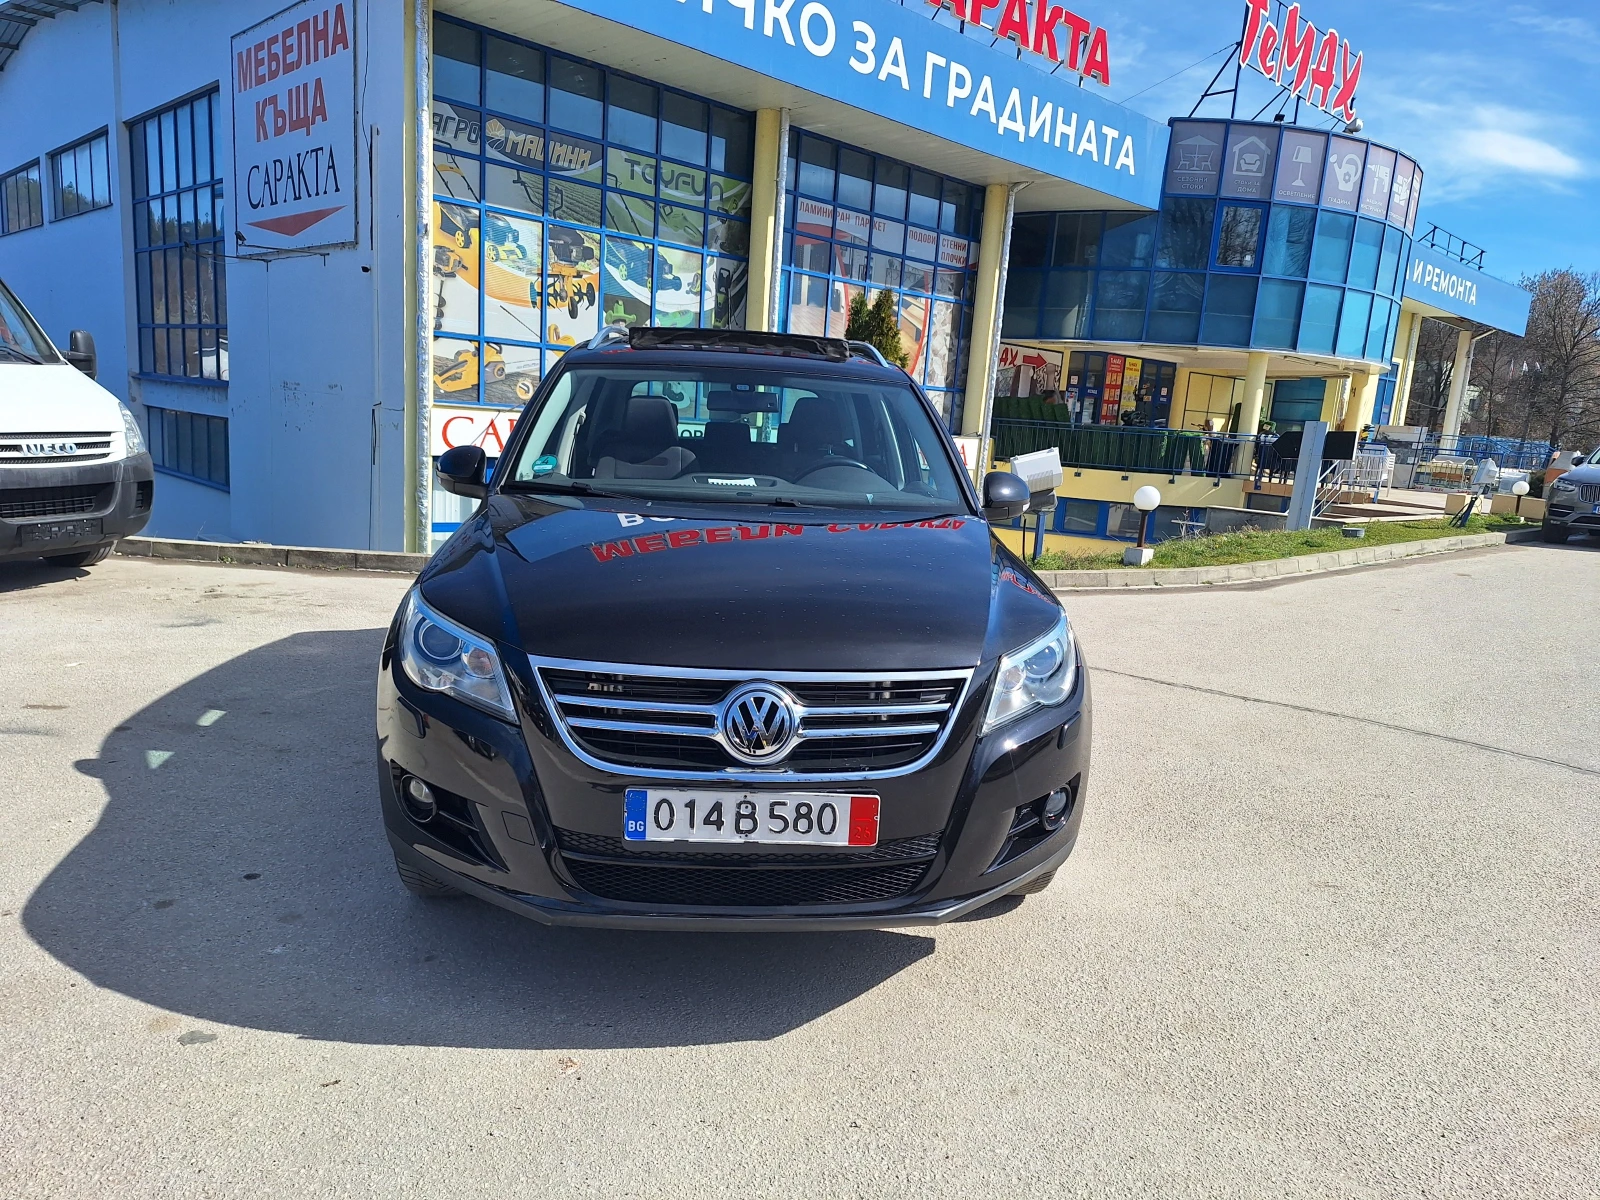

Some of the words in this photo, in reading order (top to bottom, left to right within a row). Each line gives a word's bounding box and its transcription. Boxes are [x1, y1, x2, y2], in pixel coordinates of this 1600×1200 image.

[236, 2, 350, 94] МЕБЕЛНА
[255, 77, 328, 143] КЪЩА
[848, 20, 910, 91] ЗА
[923, 51, 1135, 176] ГРАДИНАТА
[247, 143, 340, 210] САРАКТА
[1278, 189, 1316, 199] ОСВЕТЛЕНИЕ
[799, 201, 851, 224] ЛАМИНИРАН
[941, 237, 968, 252] СТЕННИ
[1412, 258, 1424, 284] И
[1423, 264, 1477, 306] РЕМОНТА
[20, 443, 77, 456] IVECO
[627, 820, 645, 832] BG
